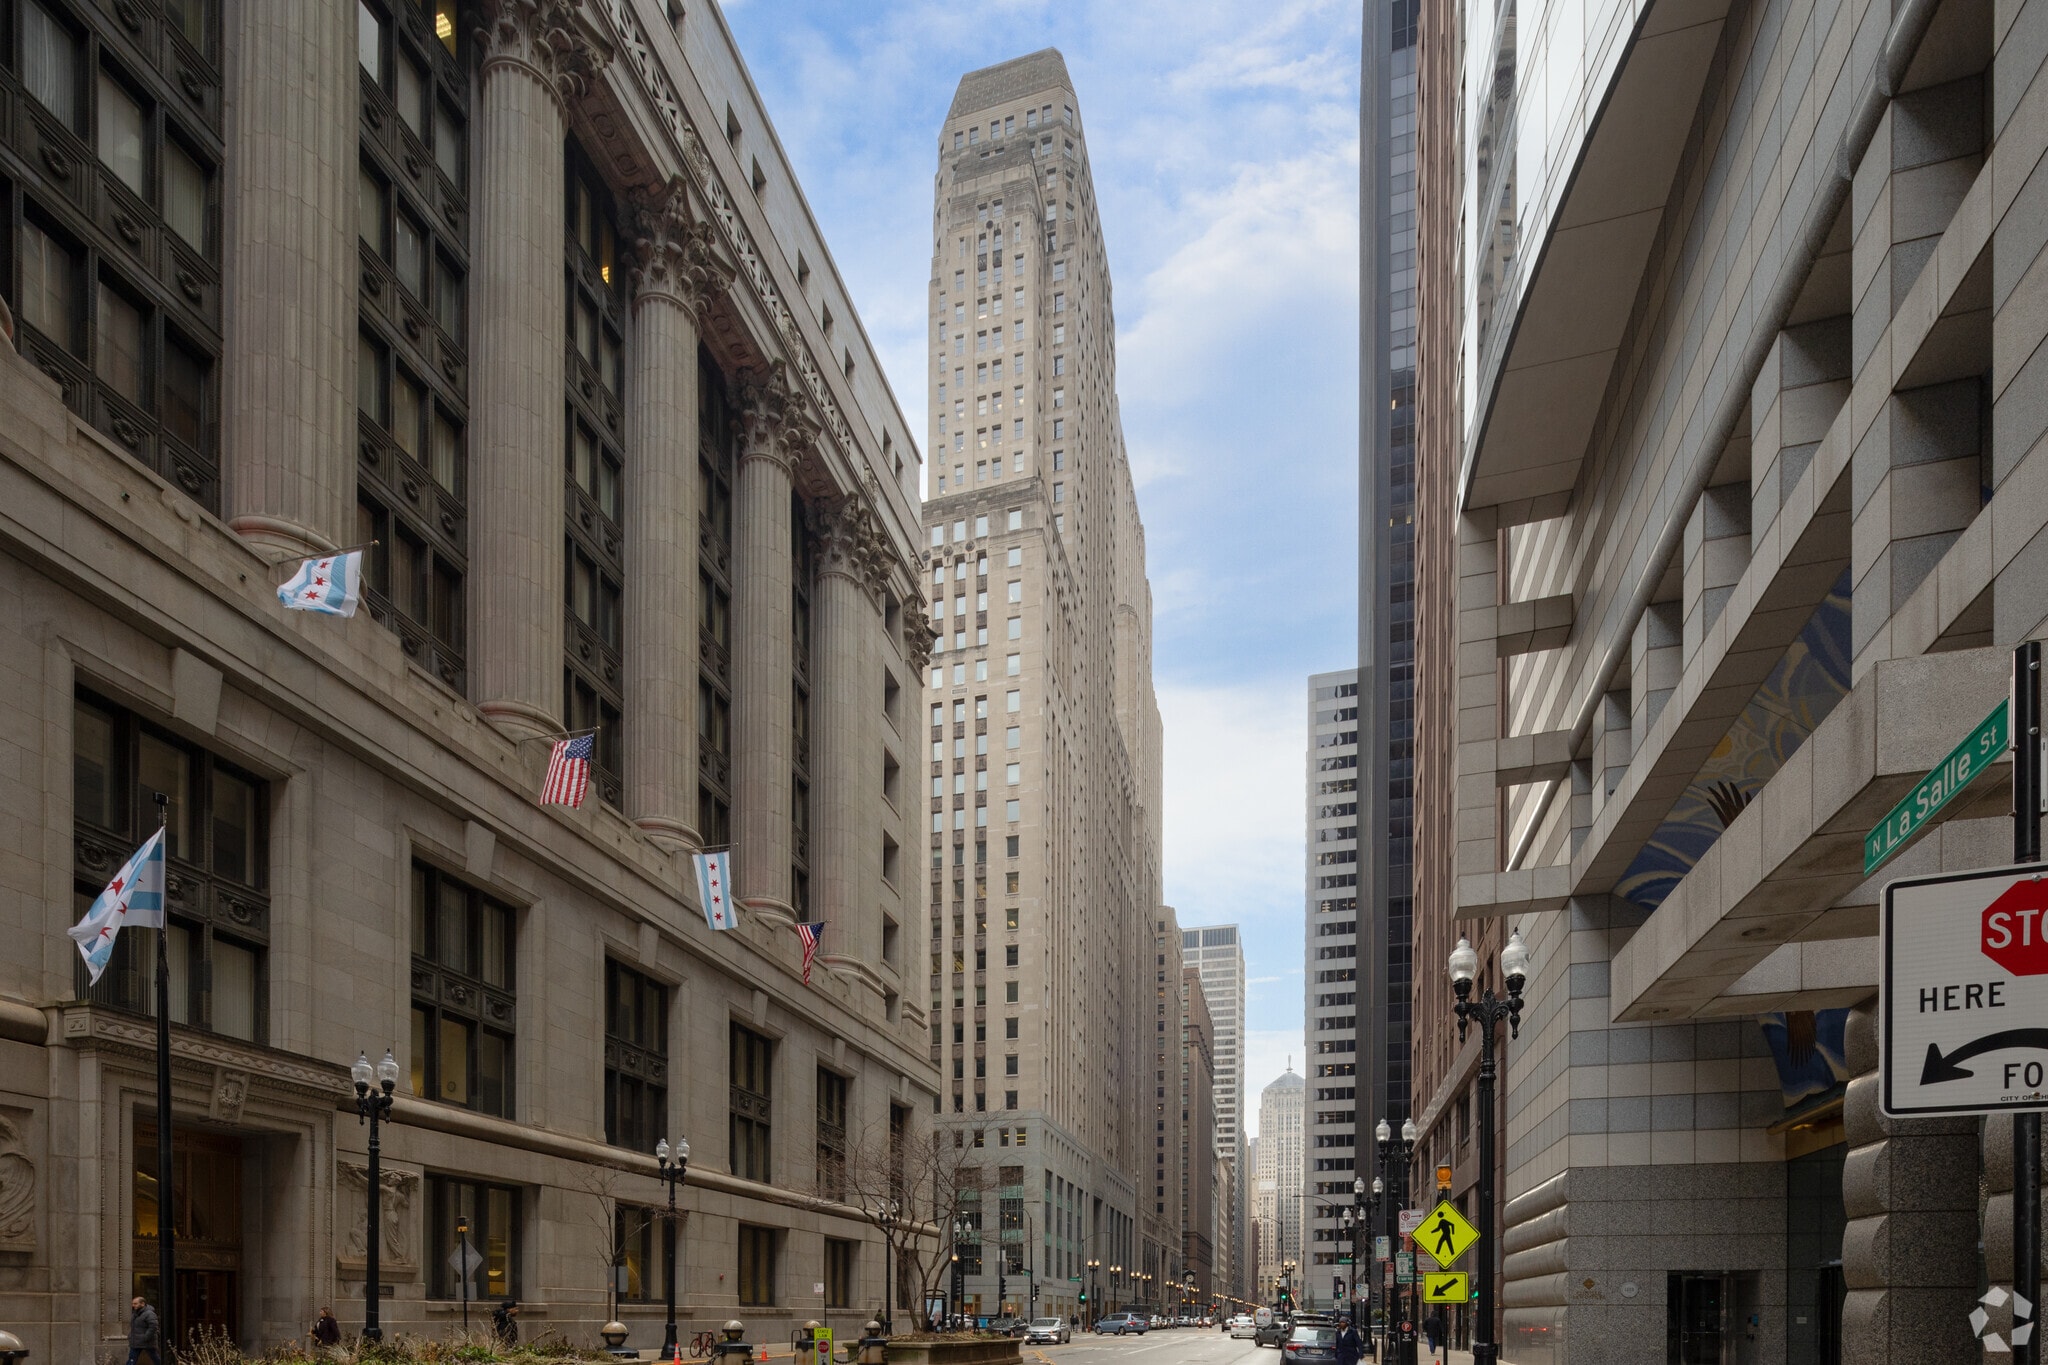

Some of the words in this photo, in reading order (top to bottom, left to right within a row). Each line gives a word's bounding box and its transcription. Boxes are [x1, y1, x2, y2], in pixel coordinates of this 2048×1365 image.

[1872, 835, 1881, 857] N
[1886, 810, 1911, 850] La
[1916, 752, 1971, 820] Salle
[1980, 725, 1998, 755] St
[1986, 909, 2048, 949] ST
[1919, 981, 2006, 1013] HERE
